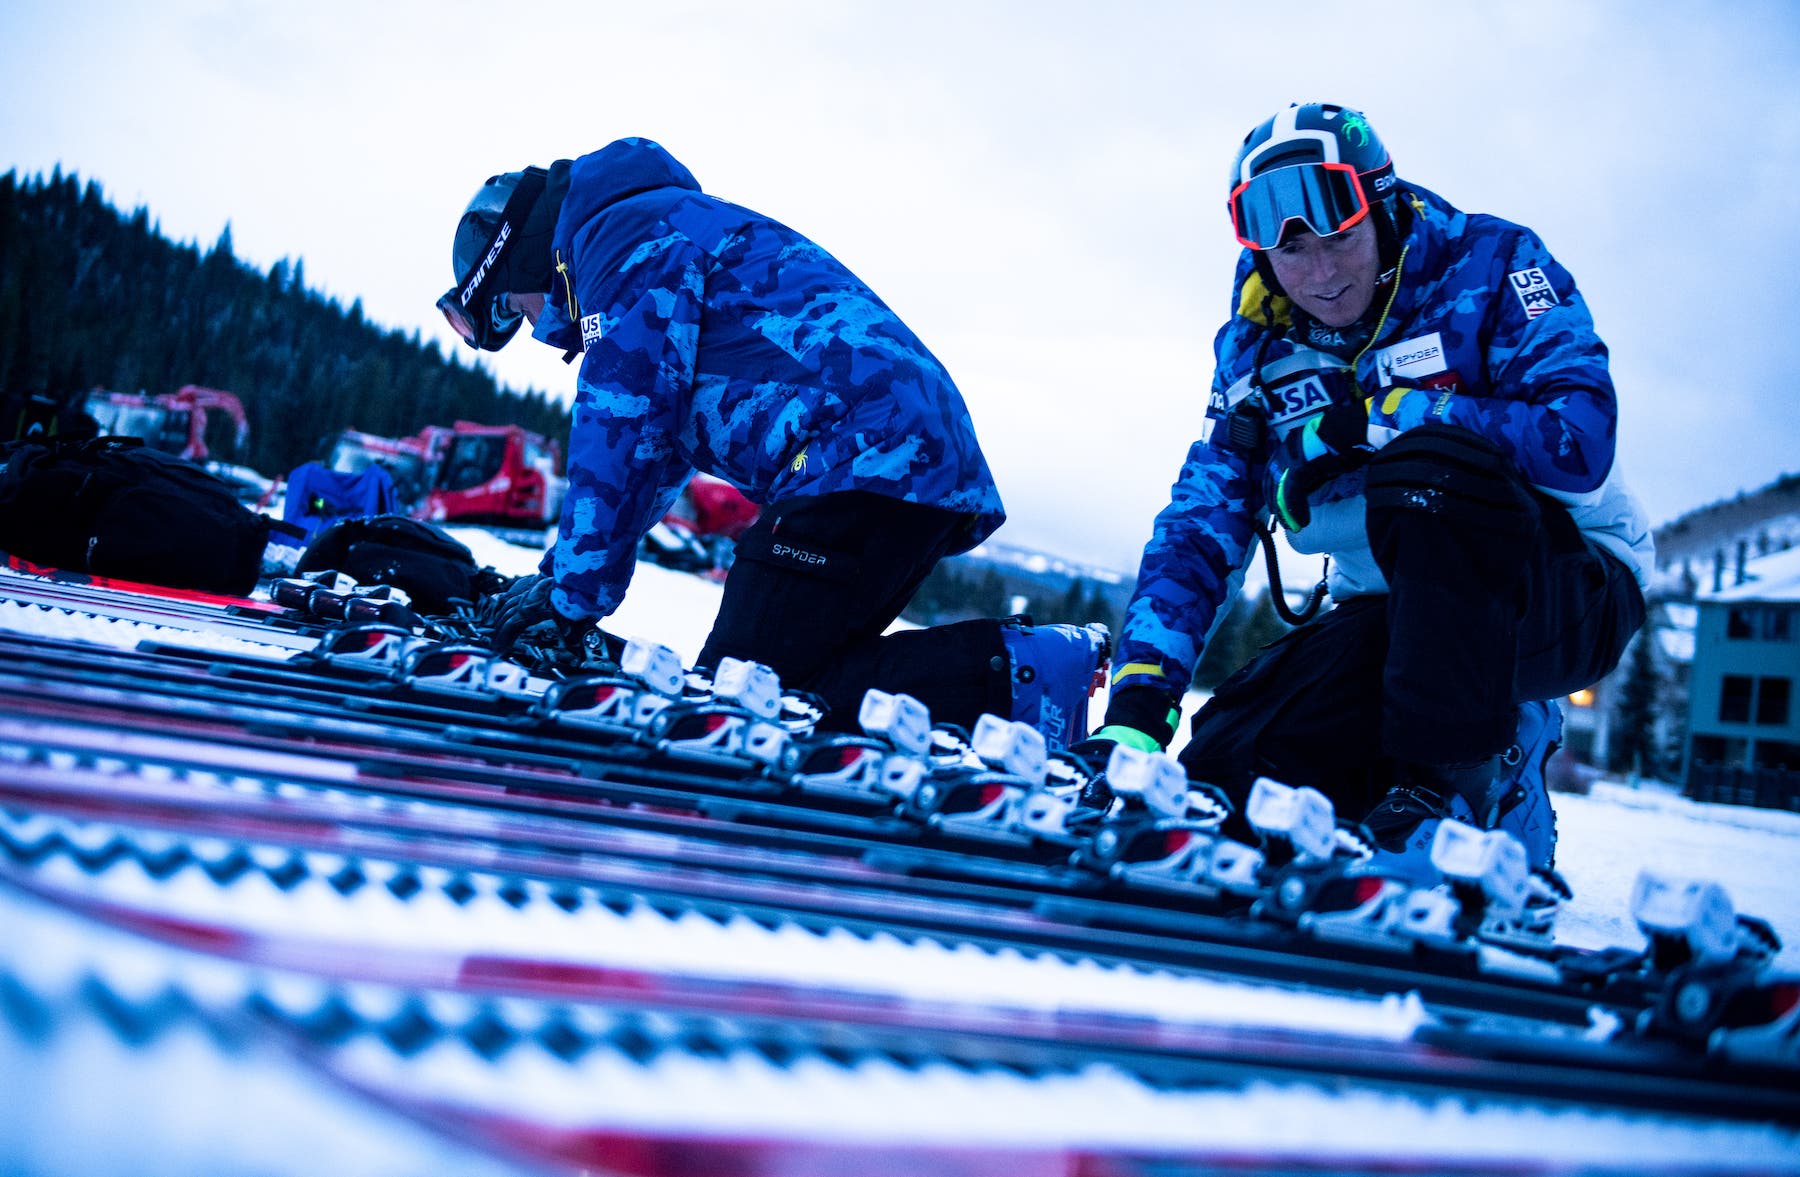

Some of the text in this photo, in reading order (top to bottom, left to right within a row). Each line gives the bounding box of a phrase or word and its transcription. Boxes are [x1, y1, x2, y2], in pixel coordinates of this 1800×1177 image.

[461, 220, 511, 307] DAINESE
[1512, 270, 1545, 289] US
[582, 316, 599, 334] US
[1395, 346, 1440, 365] SPYDER
[1269, 381, 1328, 420] SA
[772, 543, 827, 565] SPYDER
